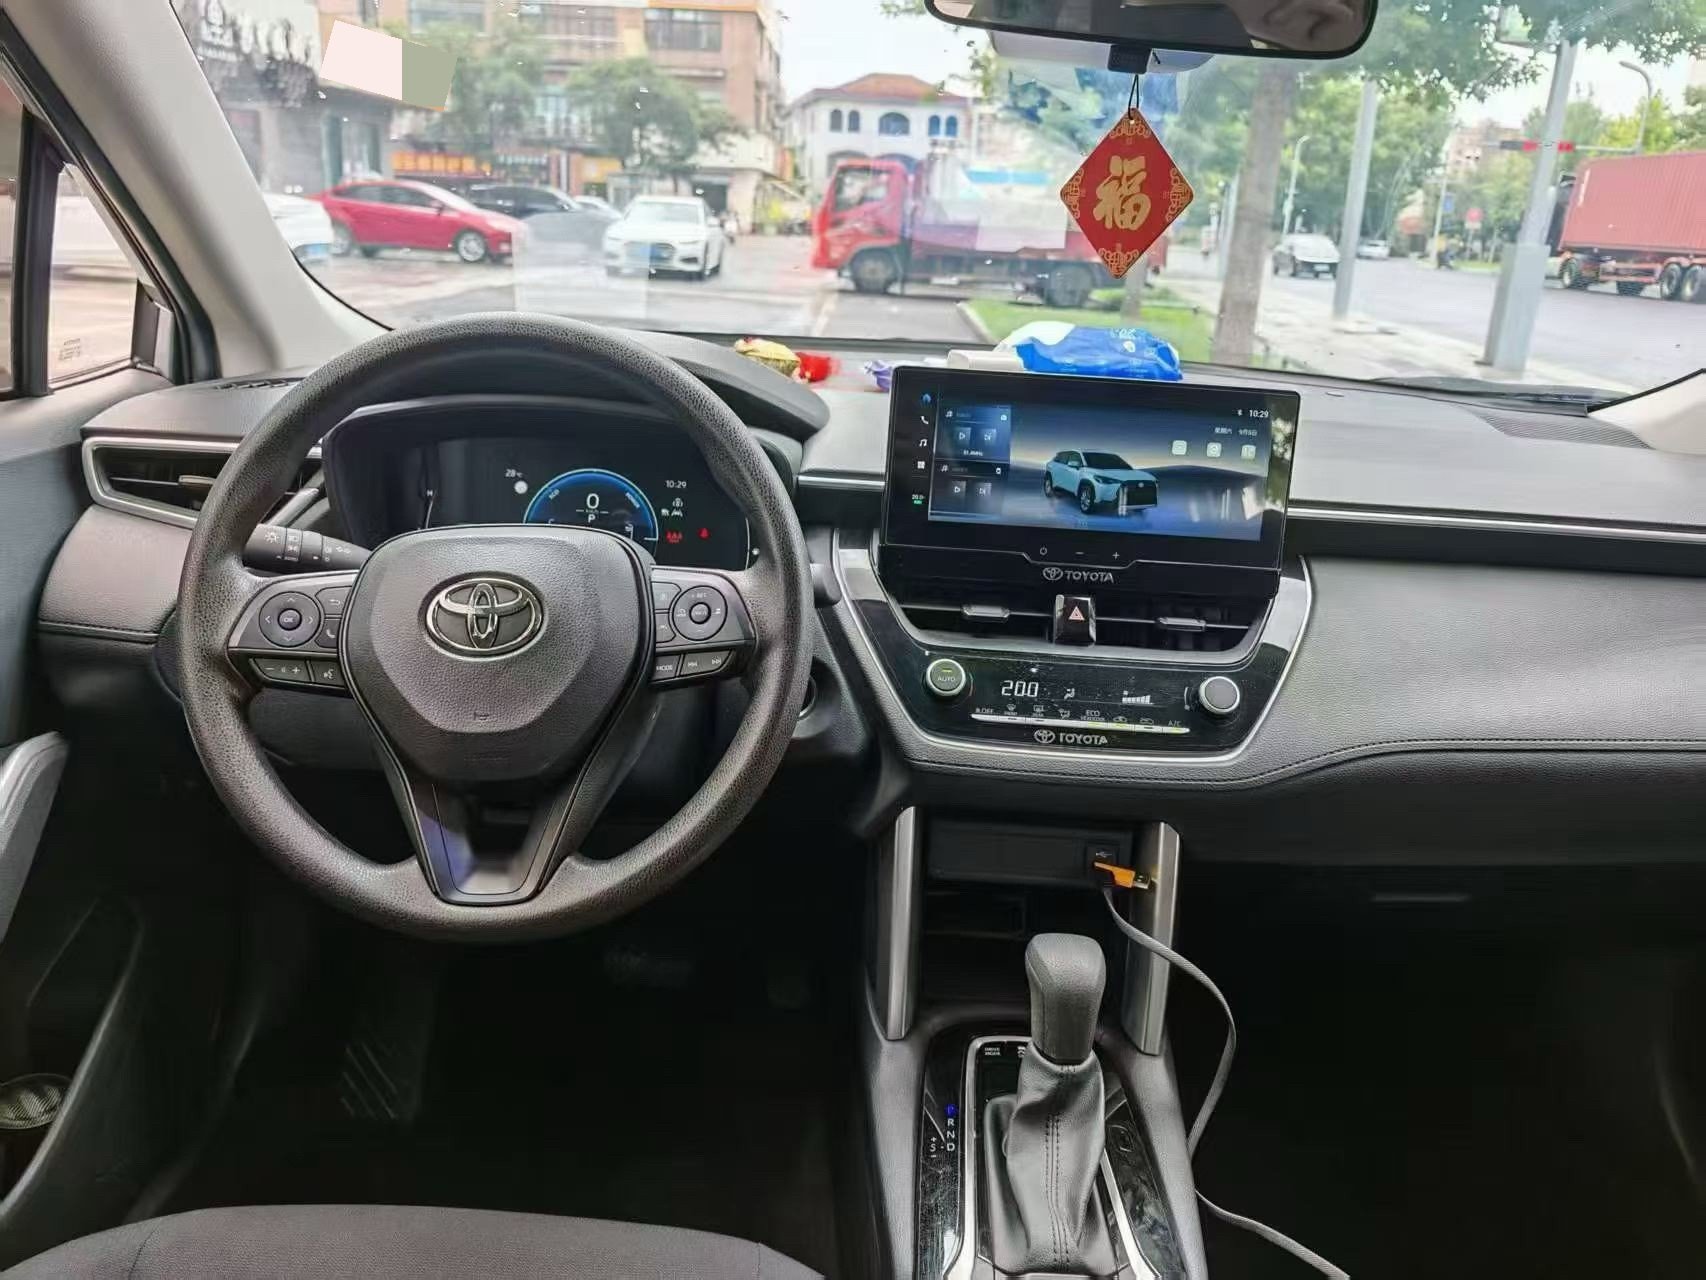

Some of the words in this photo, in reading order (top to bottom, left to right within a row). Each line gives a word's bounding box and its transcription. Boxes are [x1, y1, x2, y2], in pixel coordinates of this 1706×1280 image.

[1093, 154, 1152, 231] 福
[1249, 409, 1269, 418] 10:29
[665, 480, 687, 489] 10:29
[586, 493, 600, 509] 0
[588, 513, 596, 523] P
[1064, 570, 1114, 584] TOYOTA
[1085, 709, 1100, 717] ECO
[1059, 732, 1108, 745] TOYOTA
[947, 1118, 955, 1126] R
[946, 1130, 955, 1139] N
[930, 1143, 937, 1152] S
[946, 1142, 956, 1152] D
